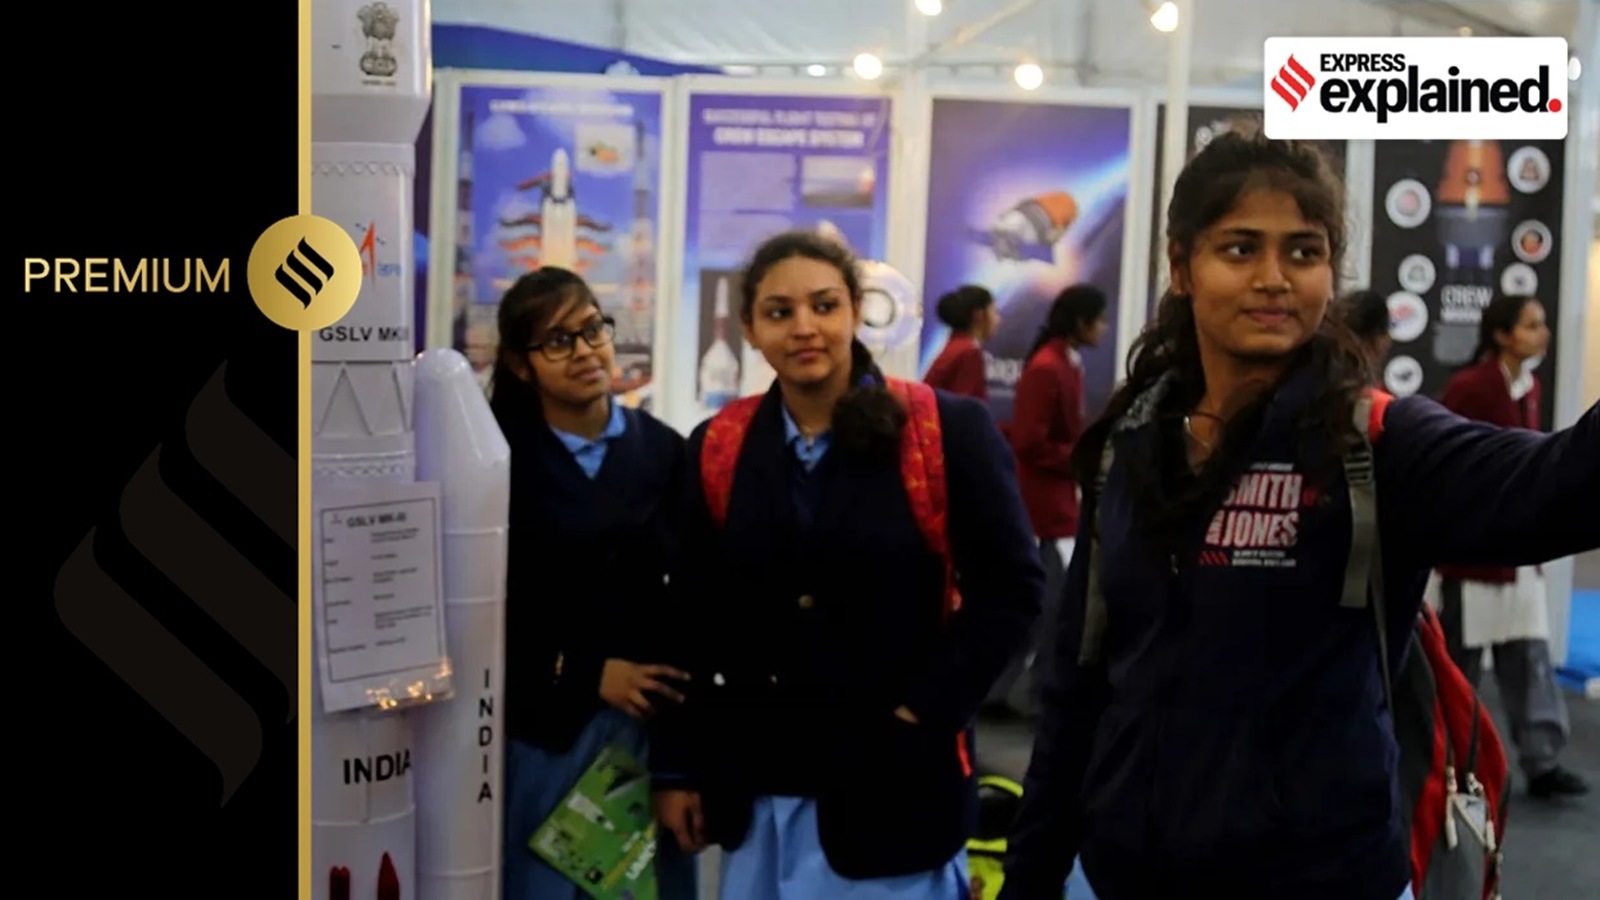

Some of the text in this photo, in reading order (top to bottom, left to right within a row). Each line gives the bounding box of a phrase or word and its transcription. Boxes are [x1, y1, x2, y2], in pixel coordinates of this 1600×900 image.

[318, 325, 373, 343] GSLV
[1221, 509, 1299, 548] JONES
[476, 668, 494, 805] INDIA
